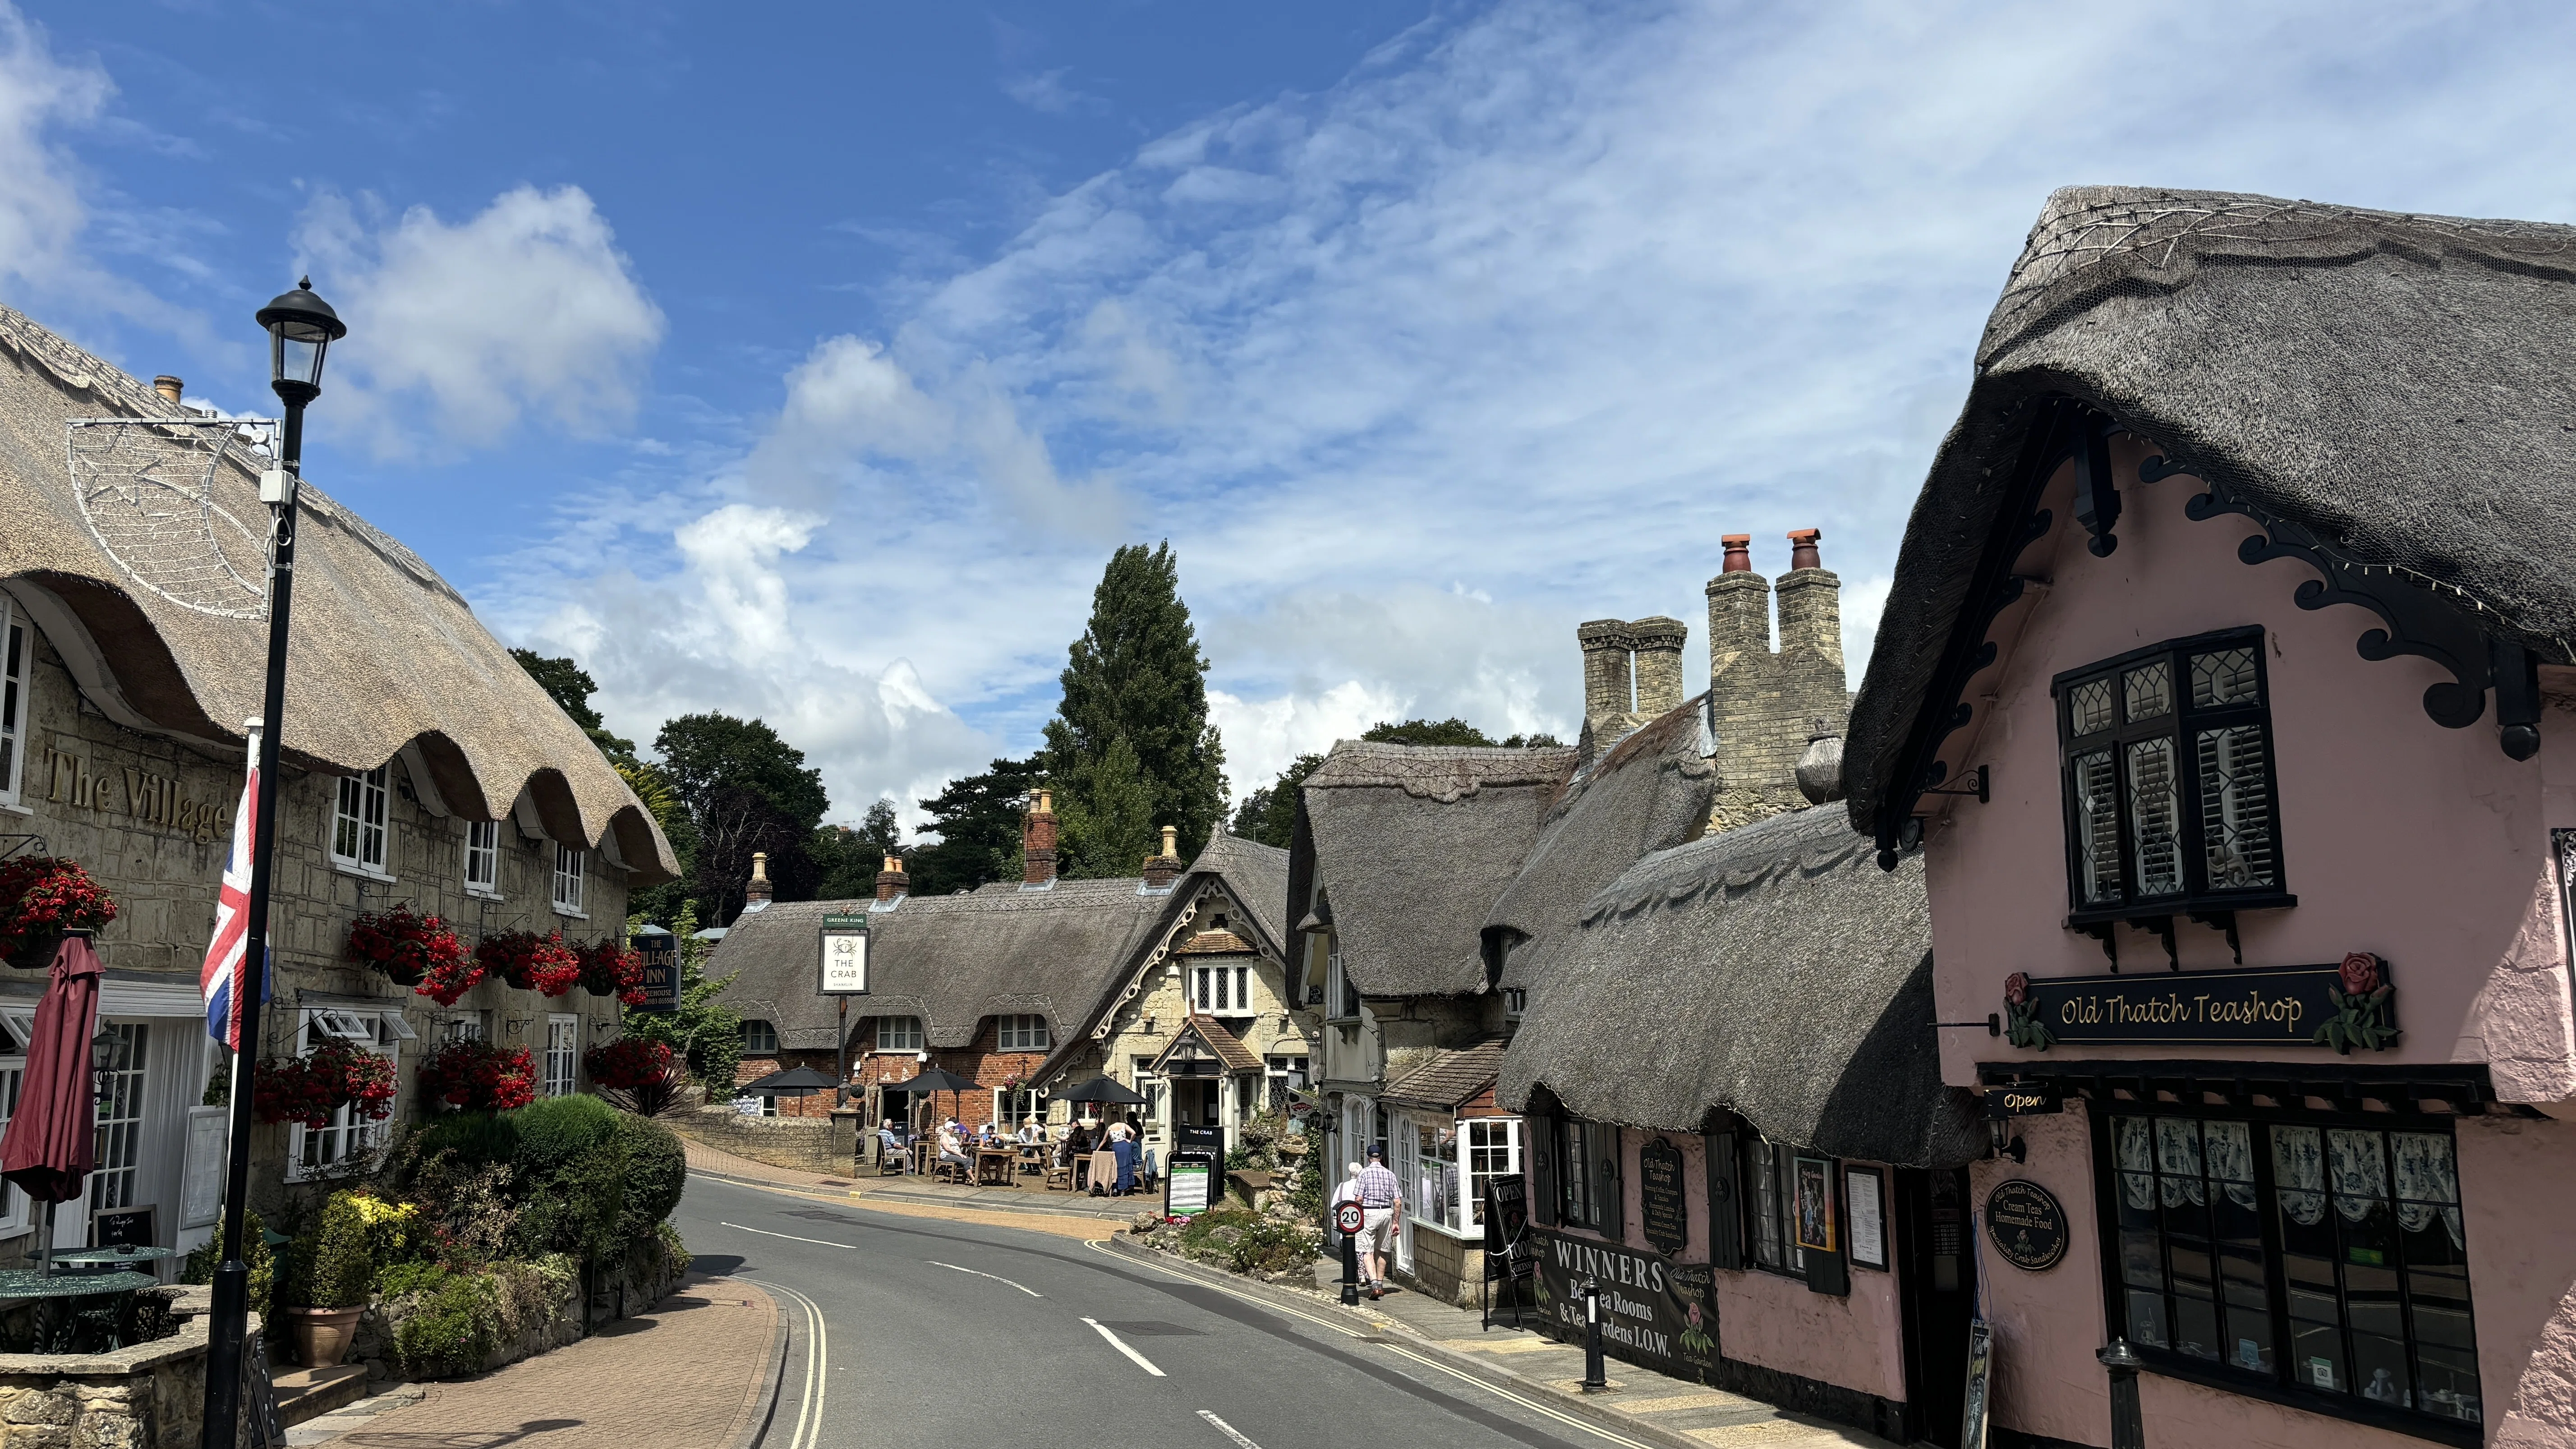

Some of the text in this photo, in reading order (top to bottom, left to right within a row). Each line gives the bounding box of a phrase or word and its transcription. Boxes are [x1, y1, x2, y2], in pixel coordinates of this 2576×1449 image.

[46, 748, 226, 845] The Village
[650, 940, 662, 948] THE
[646, 969, 665, 983] INN
[2061, 990, 2303, 1033] Old Thatch Teashop
[2004, 1092, 2047, 1113] Open
[1644, 1158, 1675, 1172] Old Thatch
[1649, 1170, 1671, 1185] Teashop
[1496, 1183, 1523, 1202] OPEN
[1995, 1186, 2050, 1211] Old Thatch Teashop
[1342, 1211, 1359, 1222] 20
[2003, 1200, 2042, 1215] Cream Teas
[1995, 1211, 2052, 1230] Homemade Food
[1989, 1225, 2013, 1258] Speciality
[2015, 1253, 2030, 1263] Crab
[2031, 1236, 2061, 1264] Sandwiches
[1554, 1239, 1663, 1293] WINNERS
[1670, 1268, 1711, 1284] Old Thatch
[1676, 1282, 1704, 1302] Teashop
[1599, 1289, 1611, 1310] ea
[1613, 1291, 1652, 1321] Rooms
[1559, 1302, 1569, 1324] &
[1601, 1317, 1633, 1345] rdens
[1634, 1326, 1671, 1358] I.O.W.
[1683, 1352, 1713, 1368] Tea Garden
